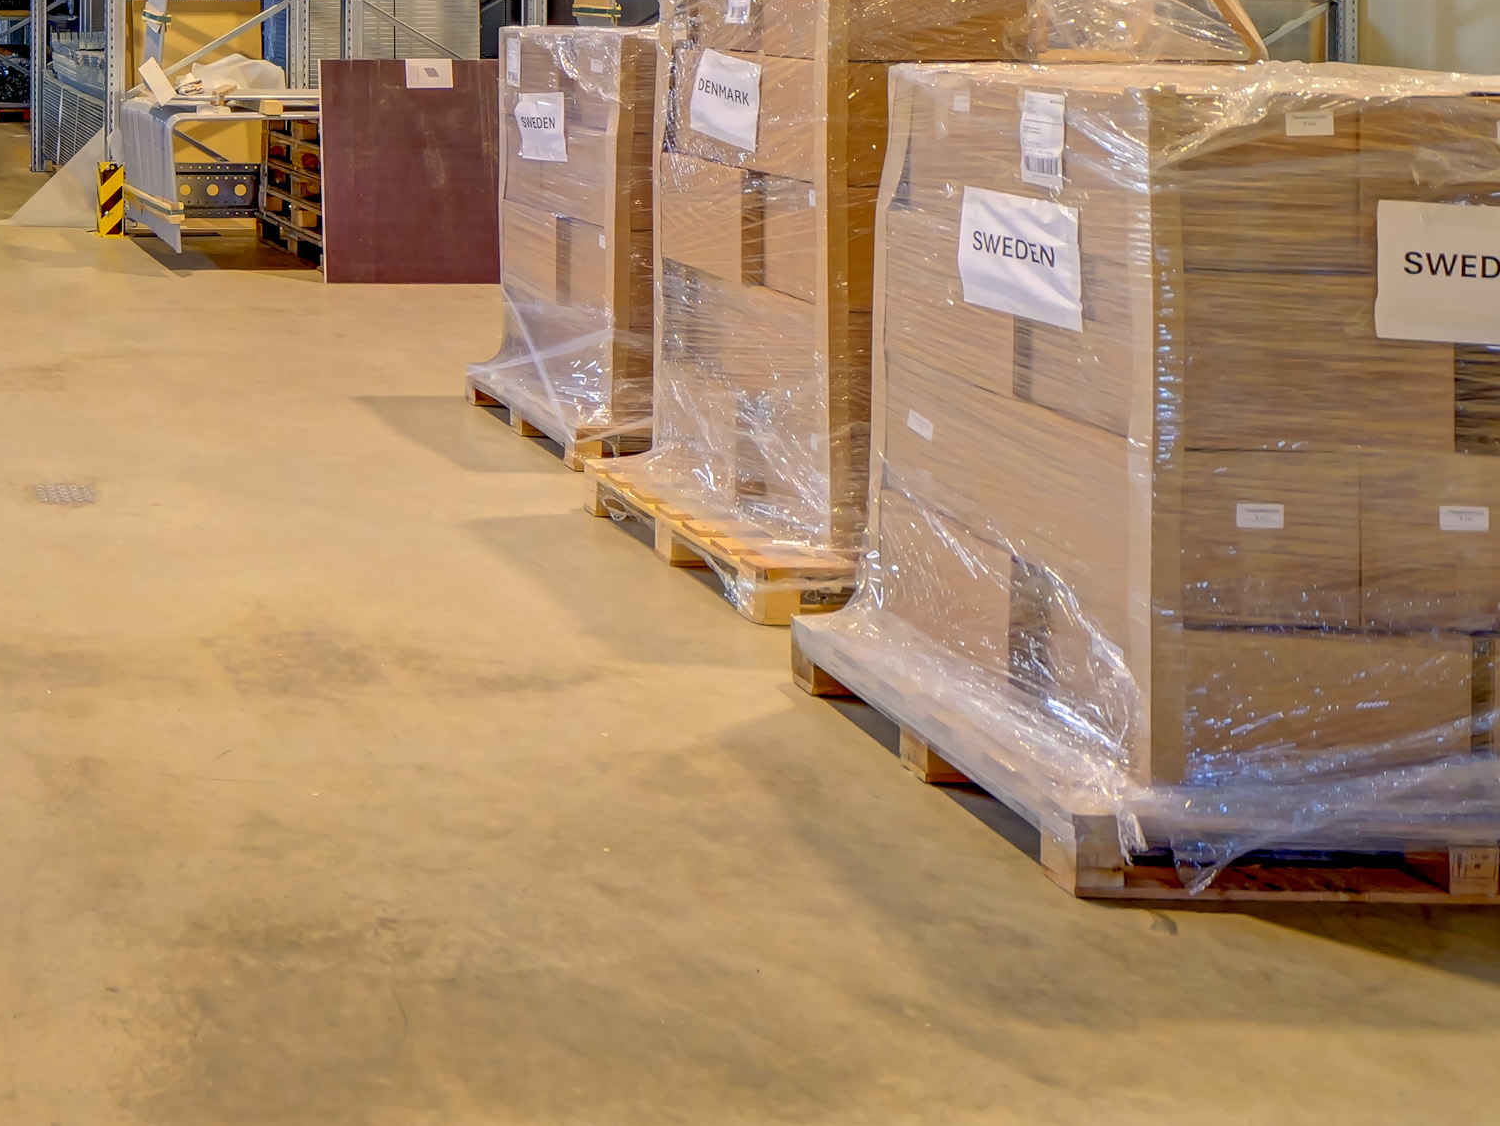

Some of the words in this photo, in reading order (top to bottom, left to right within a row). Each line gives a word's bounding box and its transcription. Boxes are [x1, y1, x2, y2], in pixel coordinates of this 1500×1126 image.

[698, 77, 750, 107] DENMARK
[521, 116, 556, 130] SWEDEN
[972, 230, 1055, 268] SWEDEN
[1404, 251, 1500, 278] SWED
